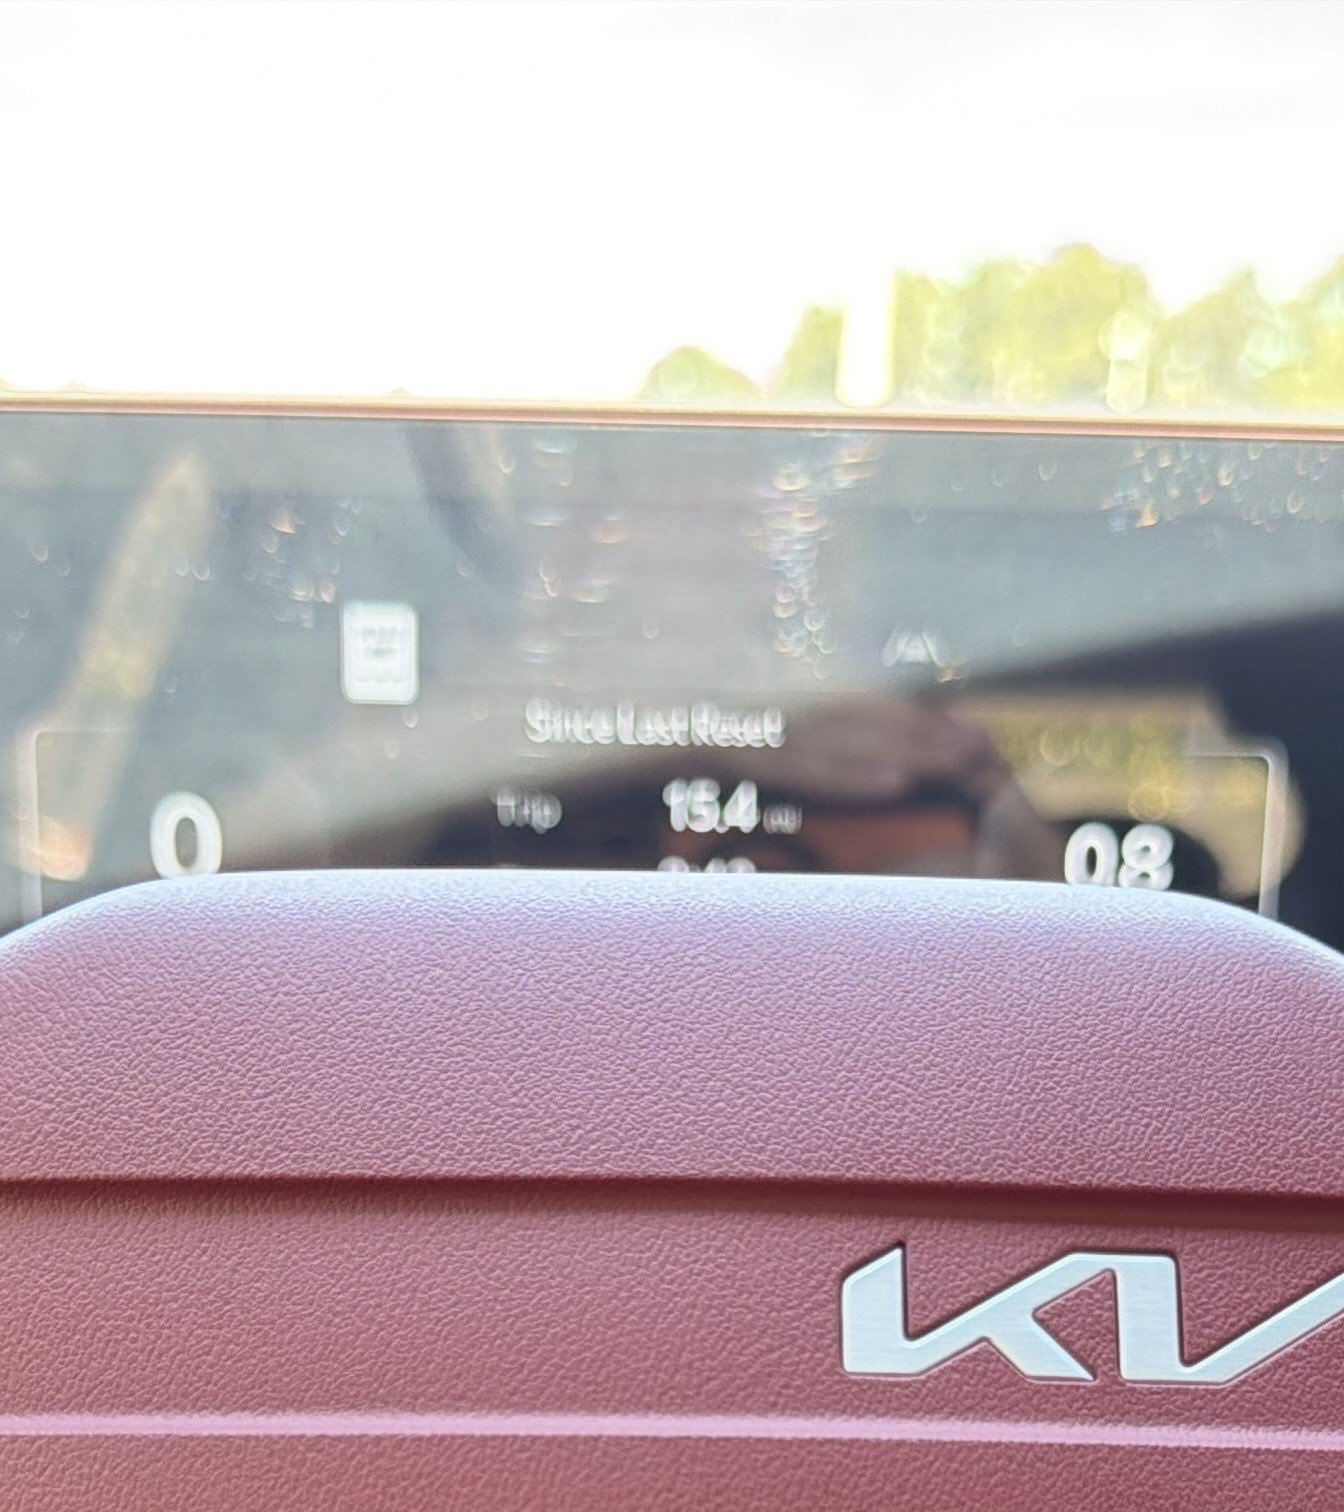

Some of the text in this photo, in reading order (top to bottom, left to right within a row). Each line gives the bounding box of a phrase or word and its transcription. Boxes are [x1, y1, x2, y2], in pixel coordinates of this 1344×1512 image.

[525, 699, 787, 748] Since Last Reset
[662, 777, 760, 833] 15.4
[150, 791, 223, 877] 0
